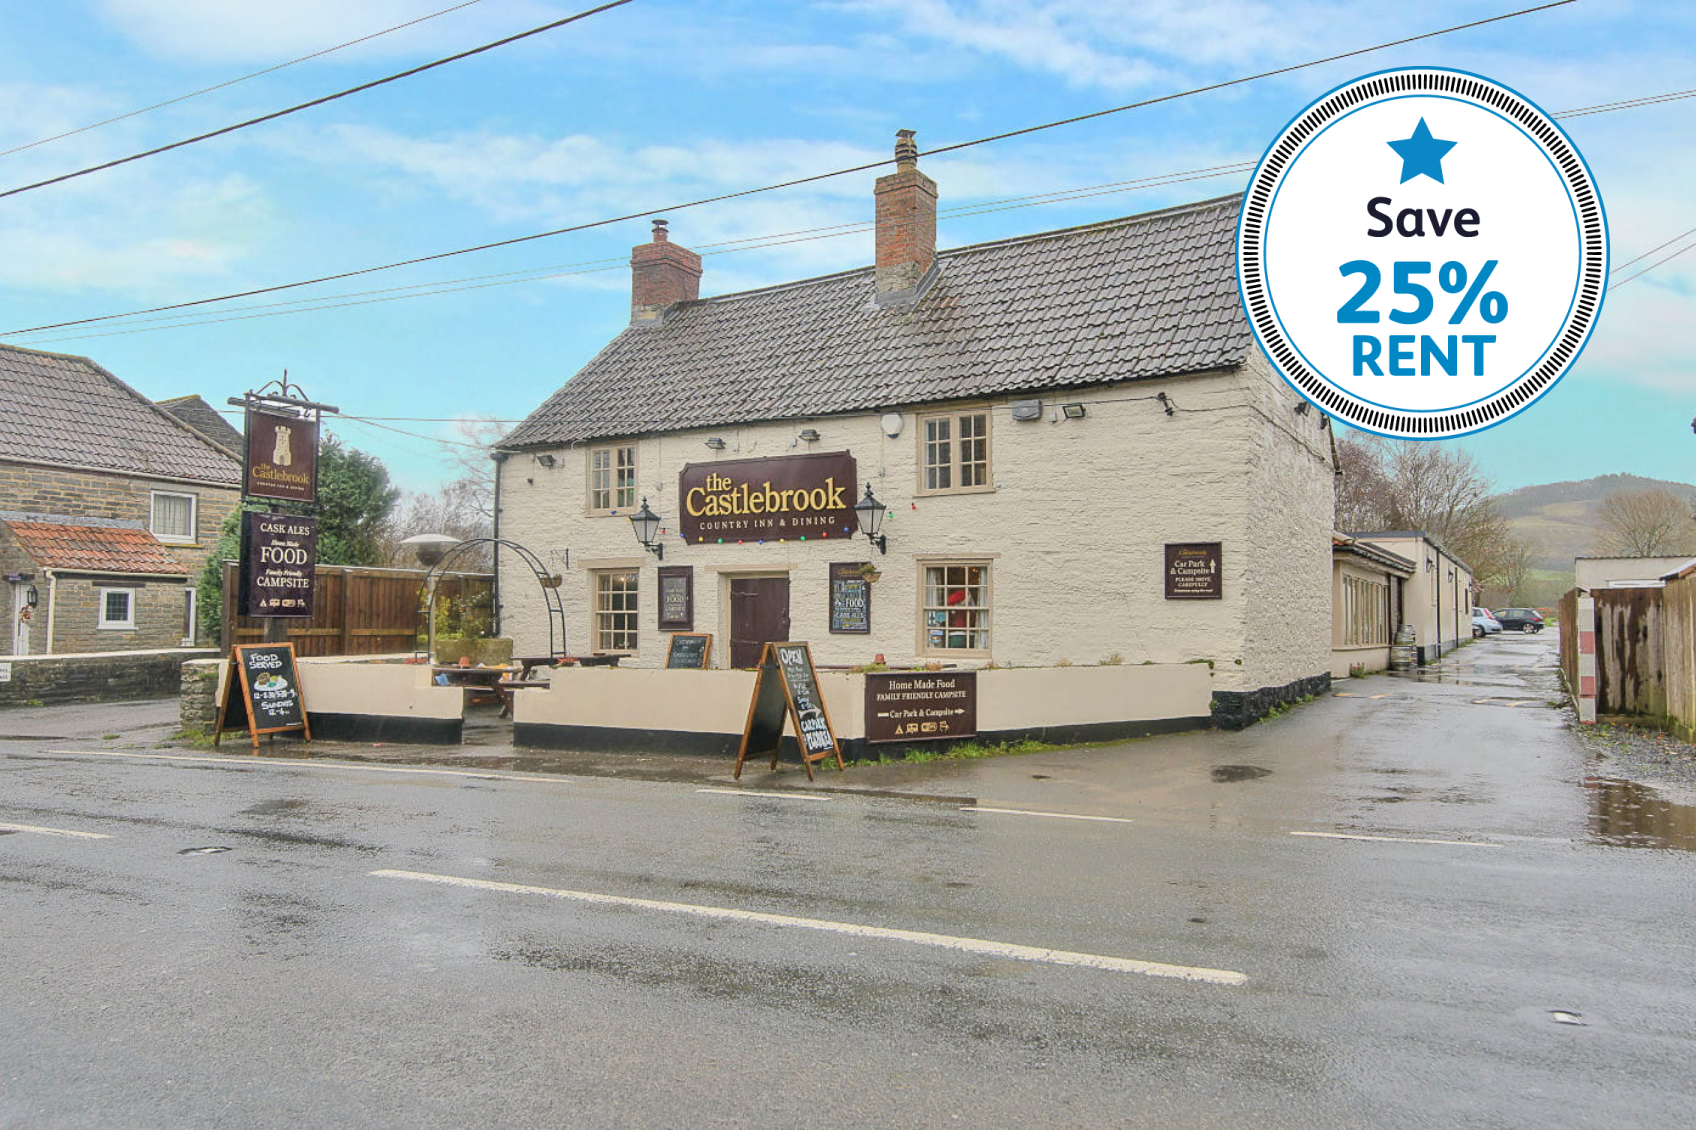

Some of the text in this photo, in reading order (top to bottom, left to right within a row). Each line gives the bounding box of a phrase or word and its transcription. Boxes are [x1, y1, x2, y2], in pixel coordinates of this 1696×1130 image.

[252, 466, 310, 485] Castlebrook
[706, 473, 732, 491] the
[686, 477, 847, 516] Castlebrook
[260, 523, 310, 535] CASK ALES
[700, 516, 835, 530] COUNTRY INN & DINING
[260, 546, 308, 565] FOOD
[1174, 560, 1206, 568] Car Park
[1177, 567, 1210, 576] Campsite
[257, 576, 310, 588] CAMPSITE
[250, 653, 278, 663] FOOD
[249, 661, 282, 669] SERVED
[889, 678, 955, 690] Home Made Food
[876, 690, 967, 701] FAMILY FRIENDLY CAMPSITE
[889, 709, 902, 718] Car
[903, 708, 918, 717] Park
[925, 707, 954, 717] Campsite
